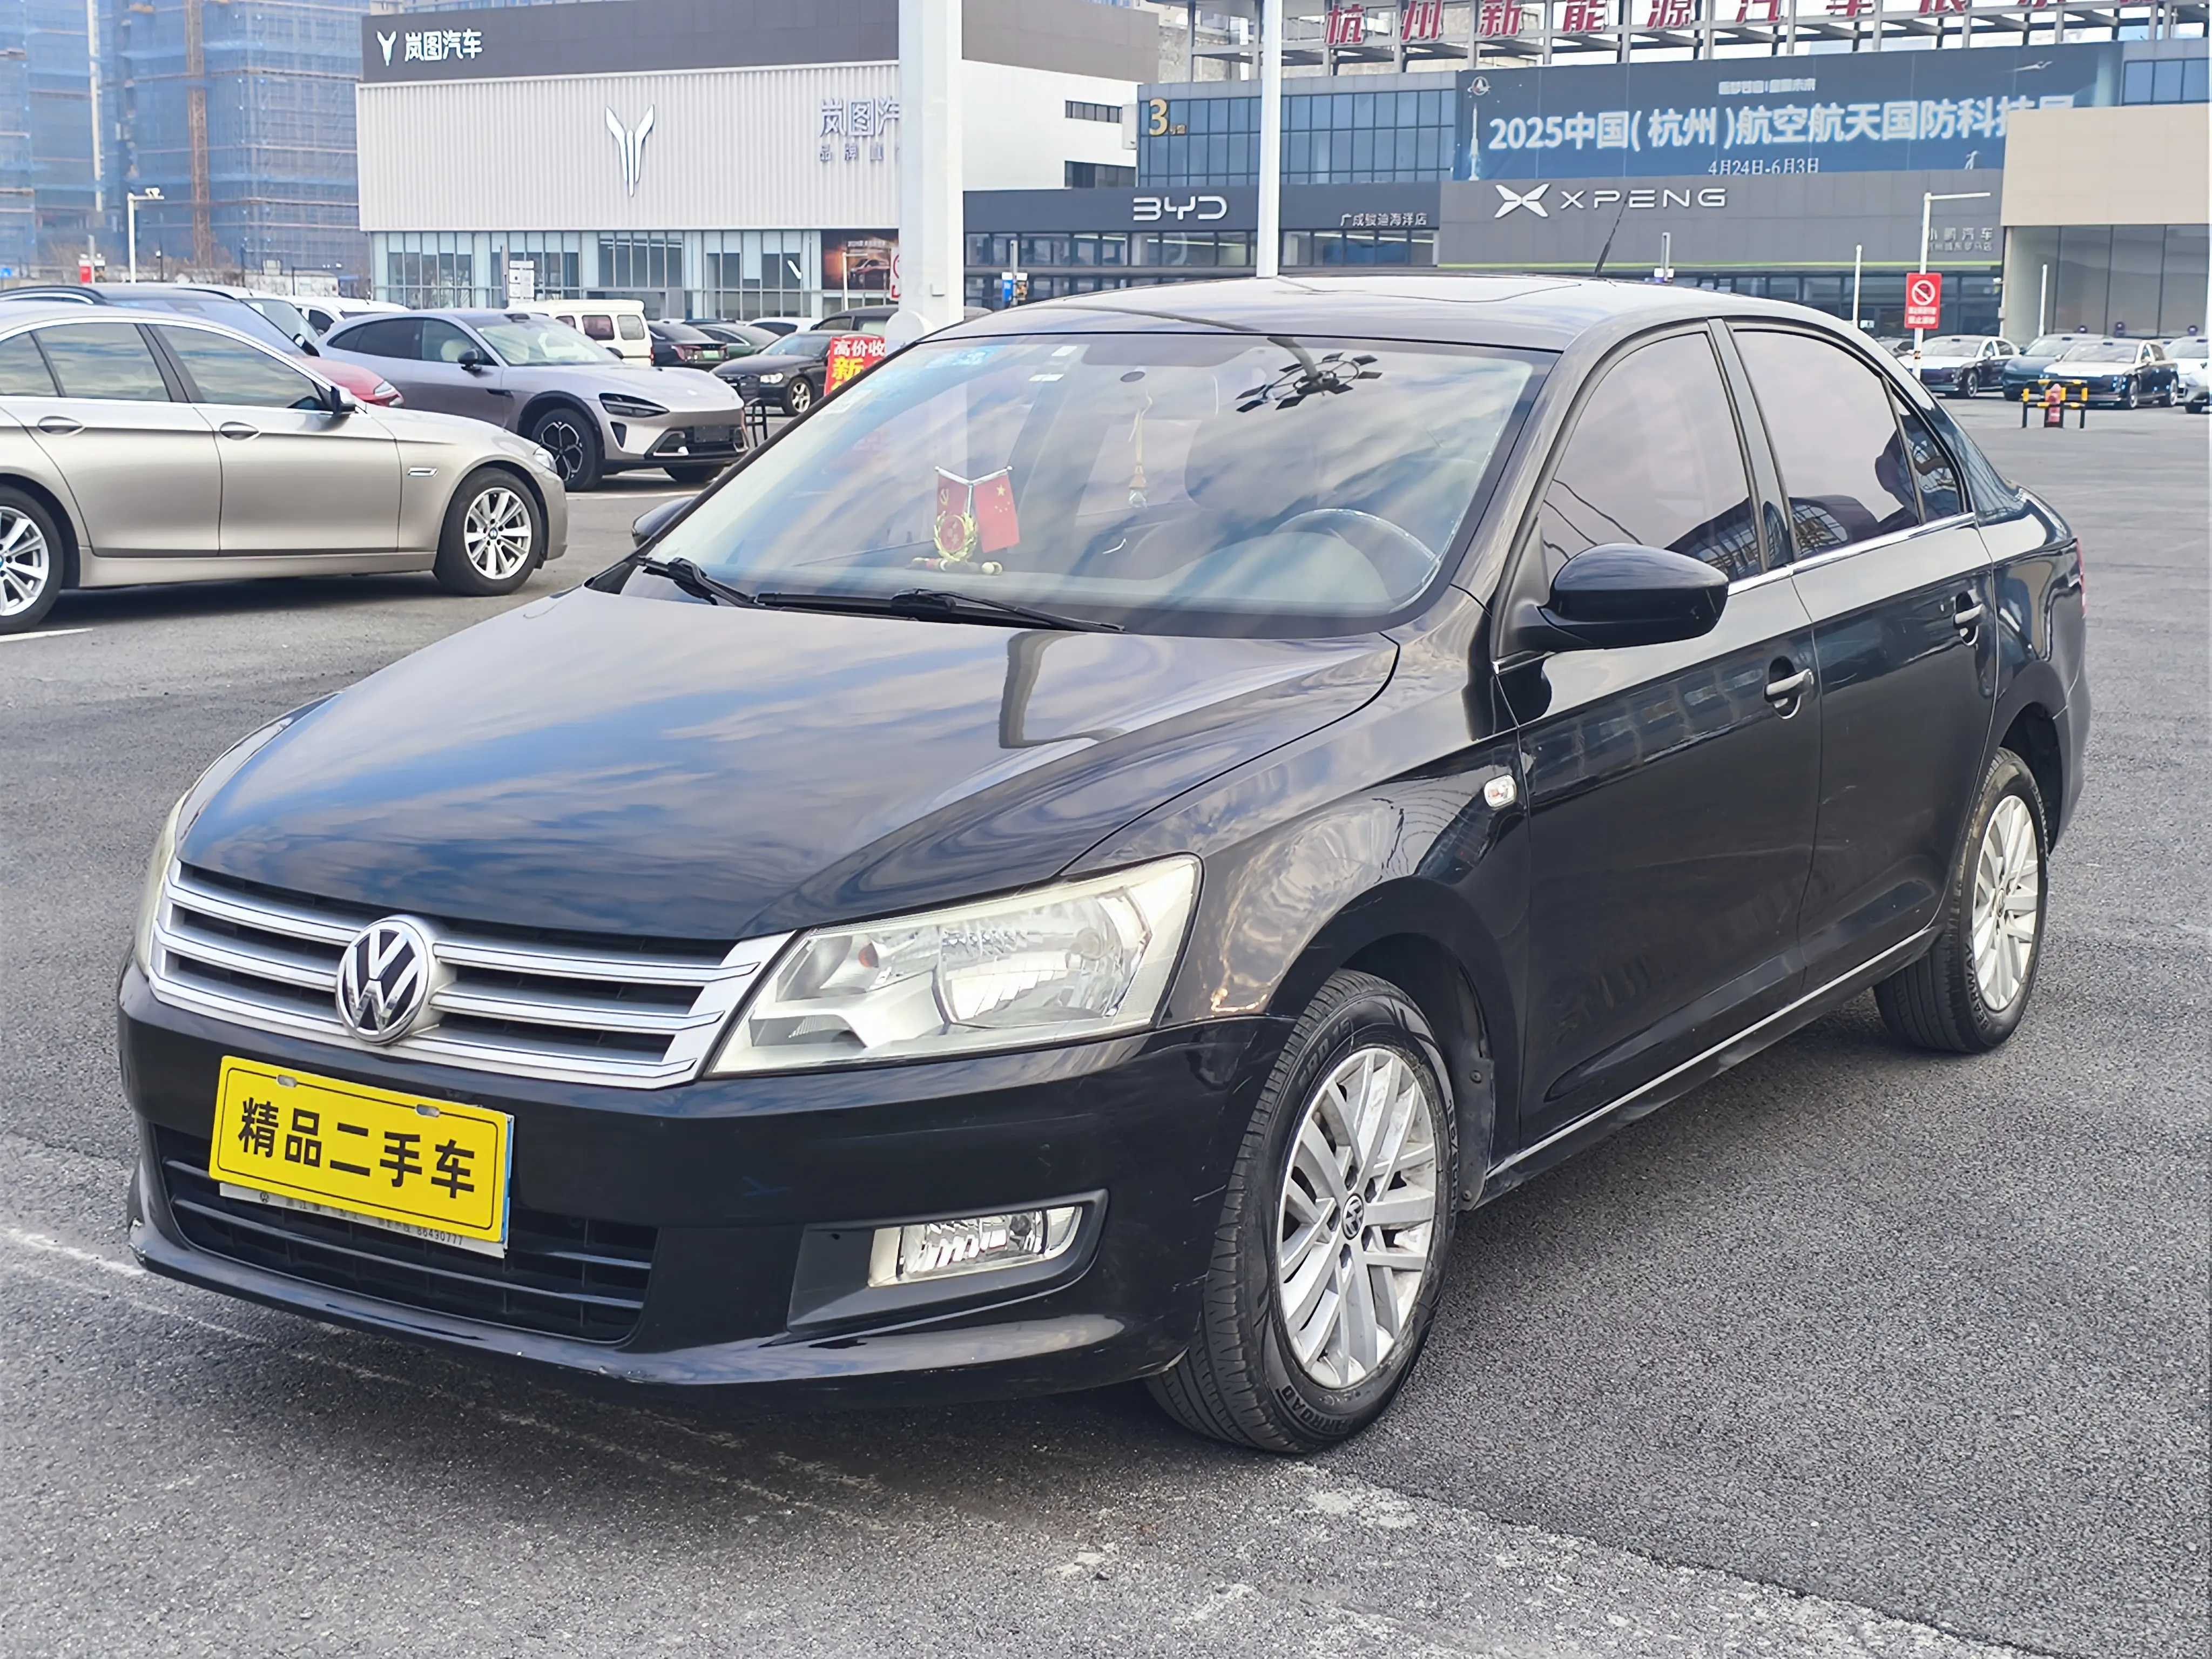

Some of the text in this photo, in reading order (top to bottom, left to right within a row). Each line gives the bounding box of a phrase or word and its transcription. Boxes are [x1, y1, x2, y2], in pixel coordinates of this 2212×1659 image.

[405, 29, 483, 62] 岚图汽车
[820, 142, 899, 161] 品牌直
[1708, 158, 1819, 176] 4月24日-6月3日
[1133, 196, 1228, 220] BYD
[1560, 188, 1728, 210] XPENG
[238, 1097, 475, 1199] 精品二手车
[1281, 1385, 1350, 1433] ARROAD
